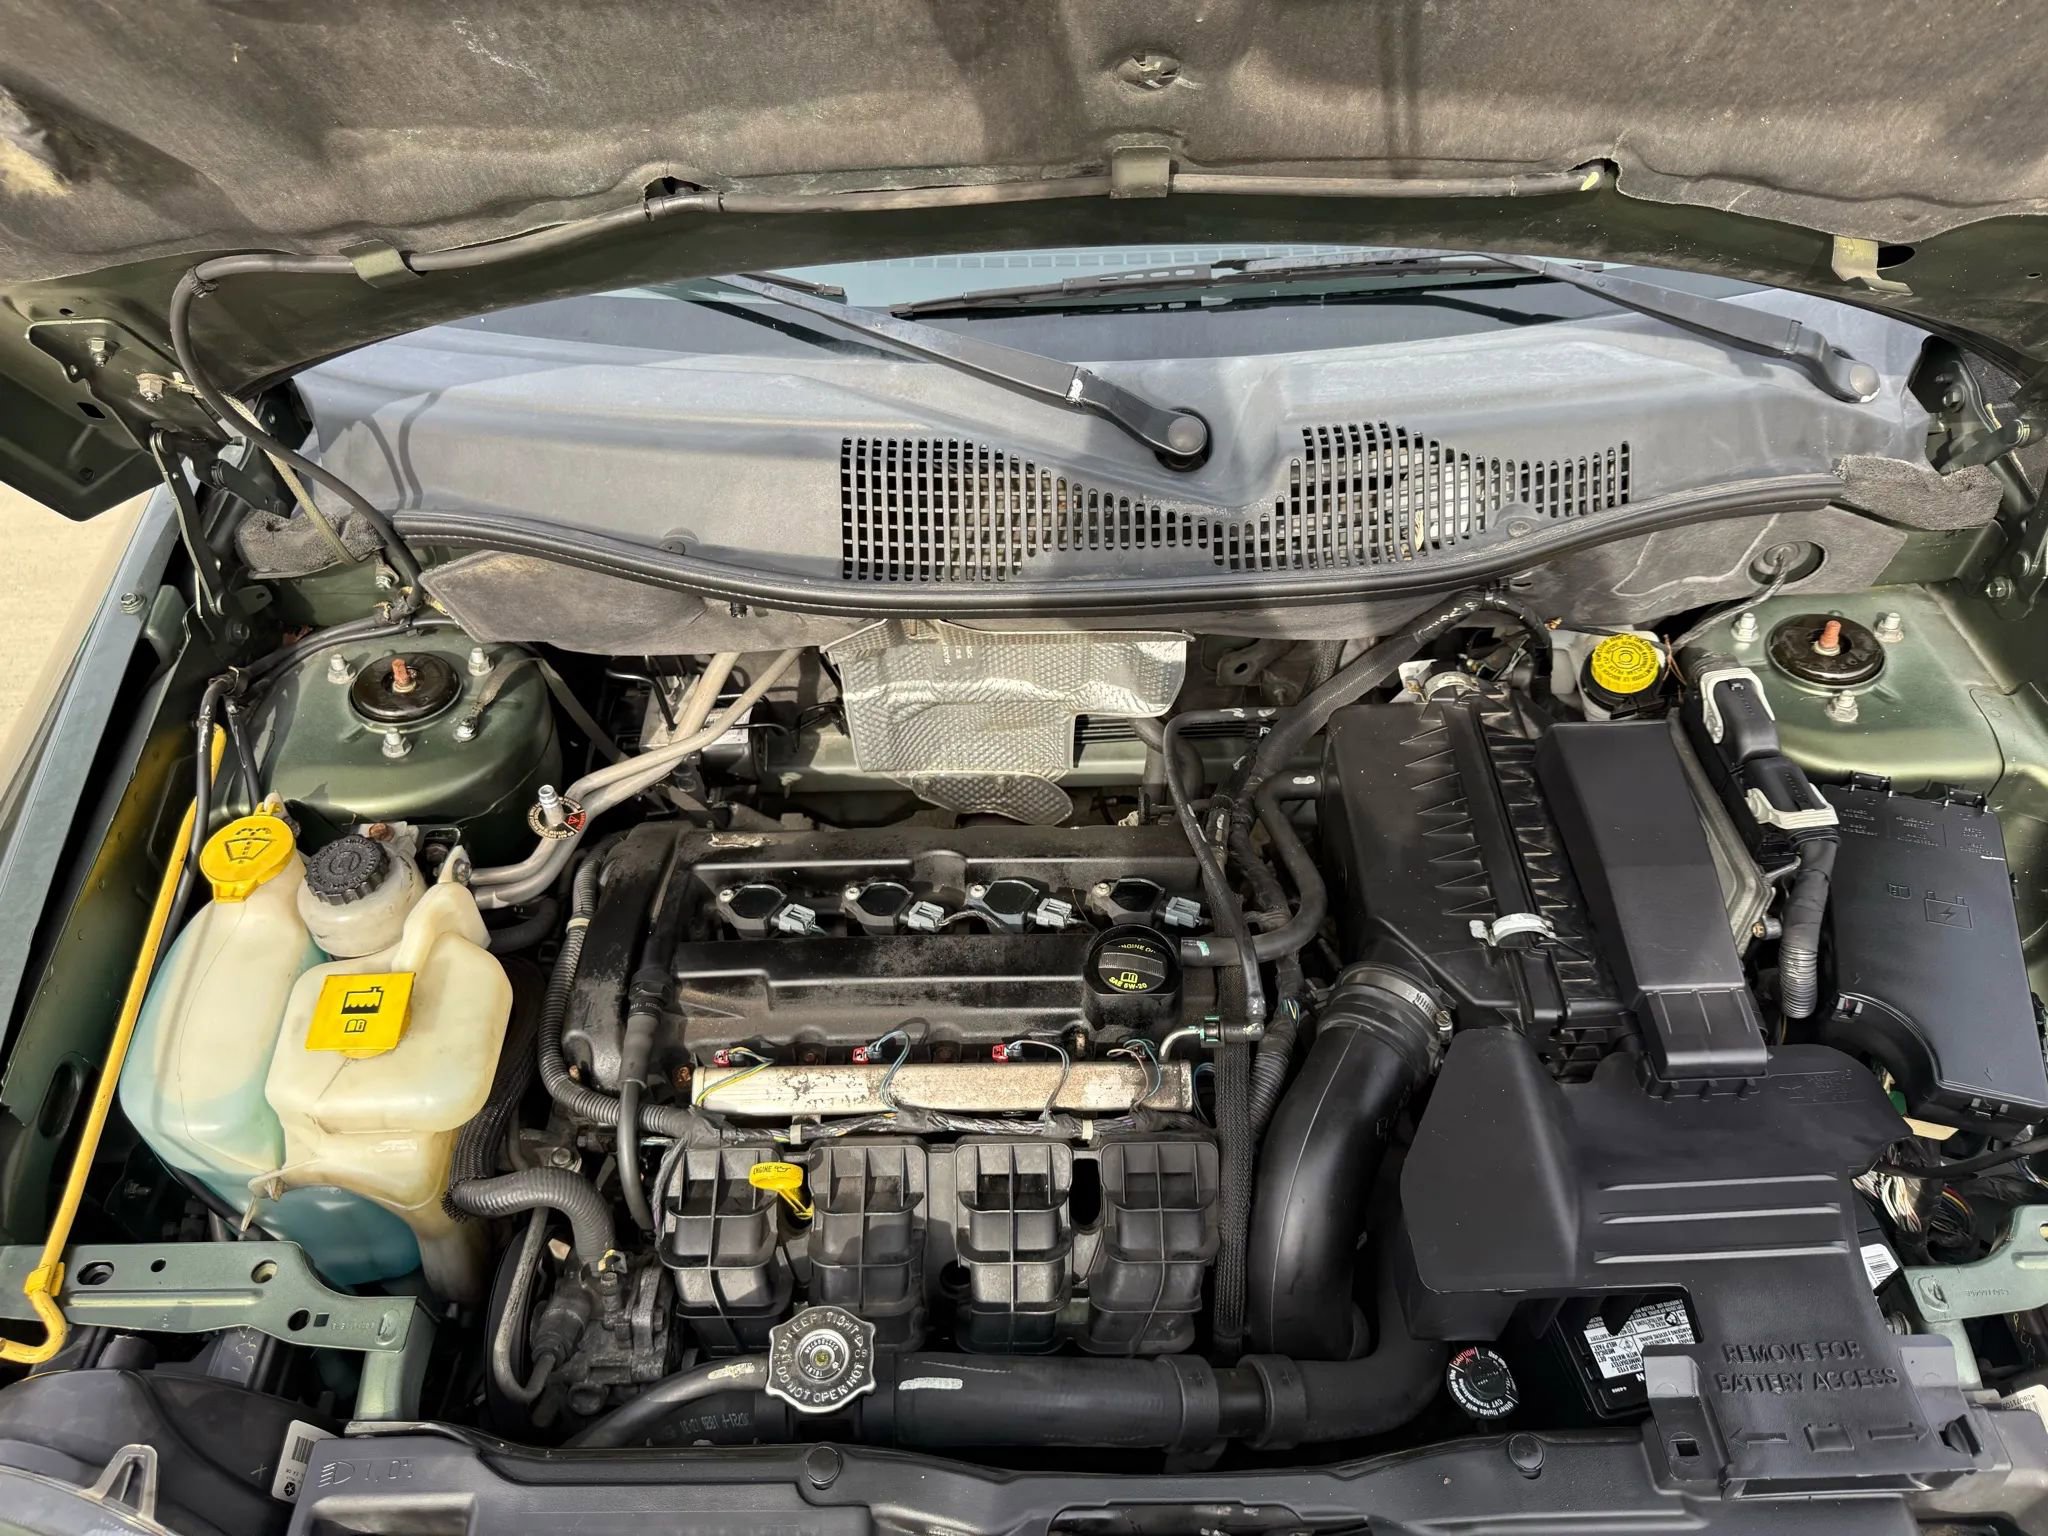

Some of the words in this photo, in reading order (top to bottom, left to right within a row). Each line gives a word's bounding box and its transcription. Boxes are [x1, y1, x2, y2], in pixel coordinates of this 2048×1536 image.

[1109, 977, 1123, 987] SAE
[753, 1166, 773, 1174] ENGINE
[826, 1311, 859, 1334] TIGHT
[1453, 1348, 1476, 1366] CAUTION
[1722, 1343, 1815, 1364] REMOVE
[1715, 1371, 1804, 1394] BATTERY
[1813, 1367, 1900, 1391] ACCESS
[788, 1383, 810, 1399] NOT
[813, 1385, 848, 1403] OPEN
[1451, 1381, 1466, 1403] damage
[1466, 1402, 1478, 1412] will
[1491, 1399, 1503, 1408] CVT
[1499, 1401, 1514, 1413] Other
[1480, 1408, 1498, 1416] fluids
